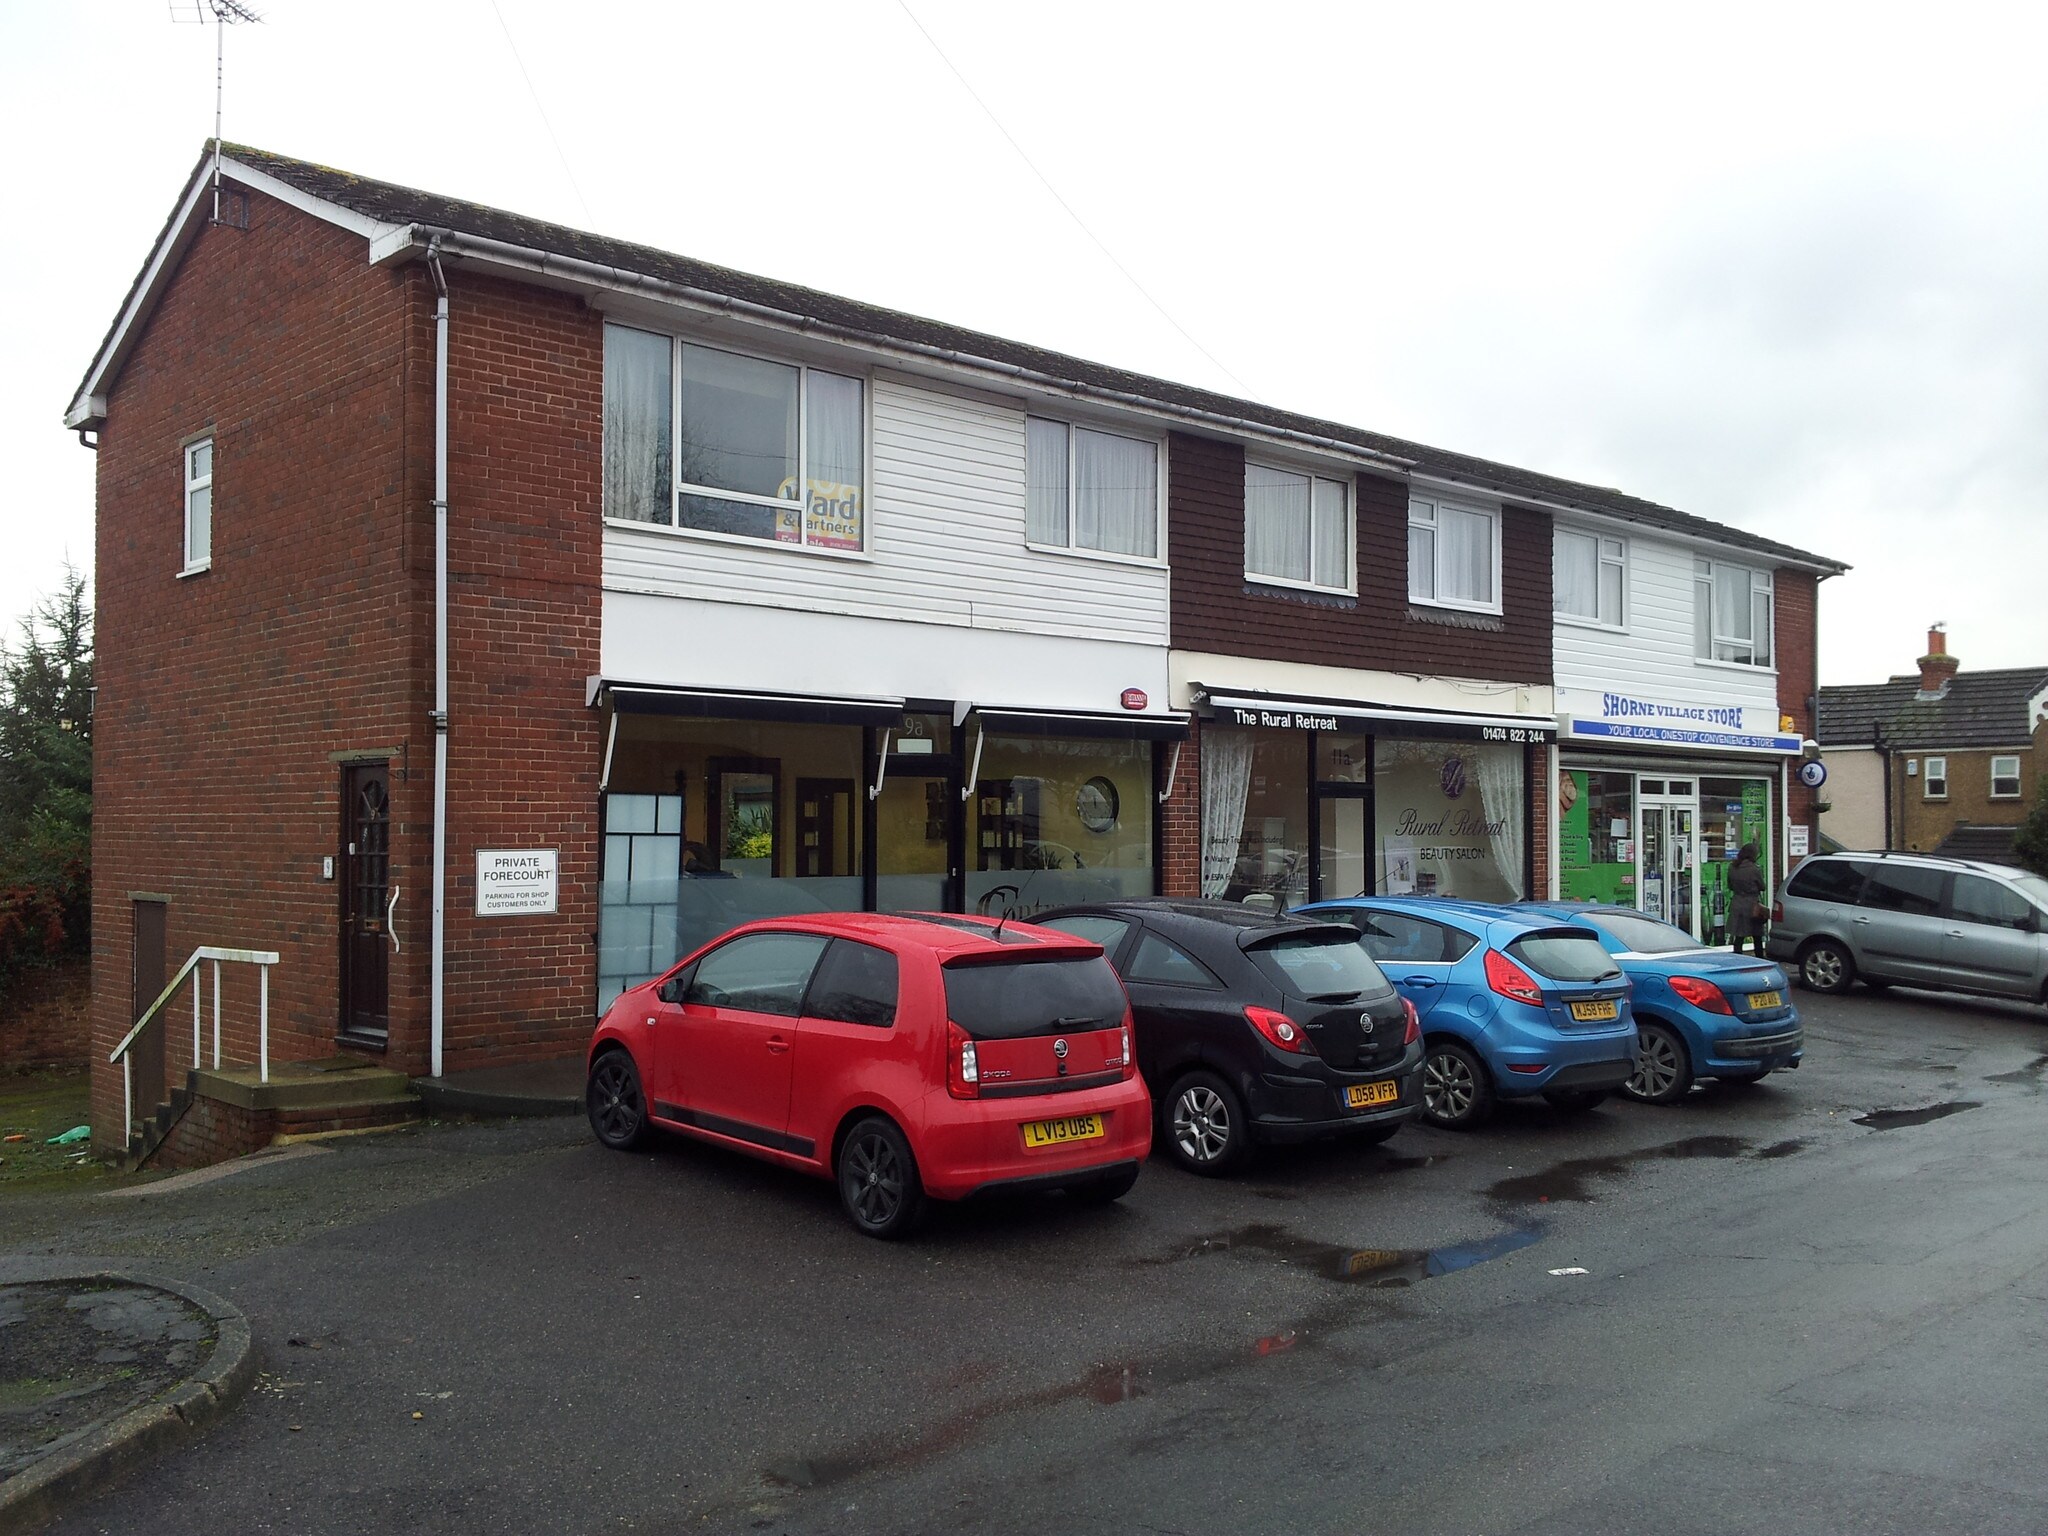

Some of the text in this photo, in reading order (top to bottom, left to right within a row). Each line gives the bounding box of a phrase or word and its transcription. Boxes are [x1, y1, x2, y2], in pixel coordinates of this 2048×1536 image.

[782, 513, 855, 535] & artners
[1603, 692, 1743, 730] SHORNE VILLAGE STORE
[905, 717, 923, 736] 9a
[1233, 709, 1338, 731] The Rural Retreat
[1482, 726, 1545, 743] 01474 822 244
[1608, 725, 1776, 748] YOUR LOCAL ONESTOP CONVENIENCE STORE
[1395, 807, 1507, 837] Rural Retreat
[1420, 847, 1485, 860] BEAUTY SALON
[495, 857, 540, 868] PRIVATE
[483, 870, 551, 881] FORECOURT
[485, 892, 515, 900] PARKING
[531, 891, 549, 899] SHOP
[1646, 892, 1659, 904] Play
[487, 901, 529, 909] CUSTOMERS
[1375, 1082, 1396, 1099] VFR
[1032, 1117, 1096, 1142] LV13 UBS
